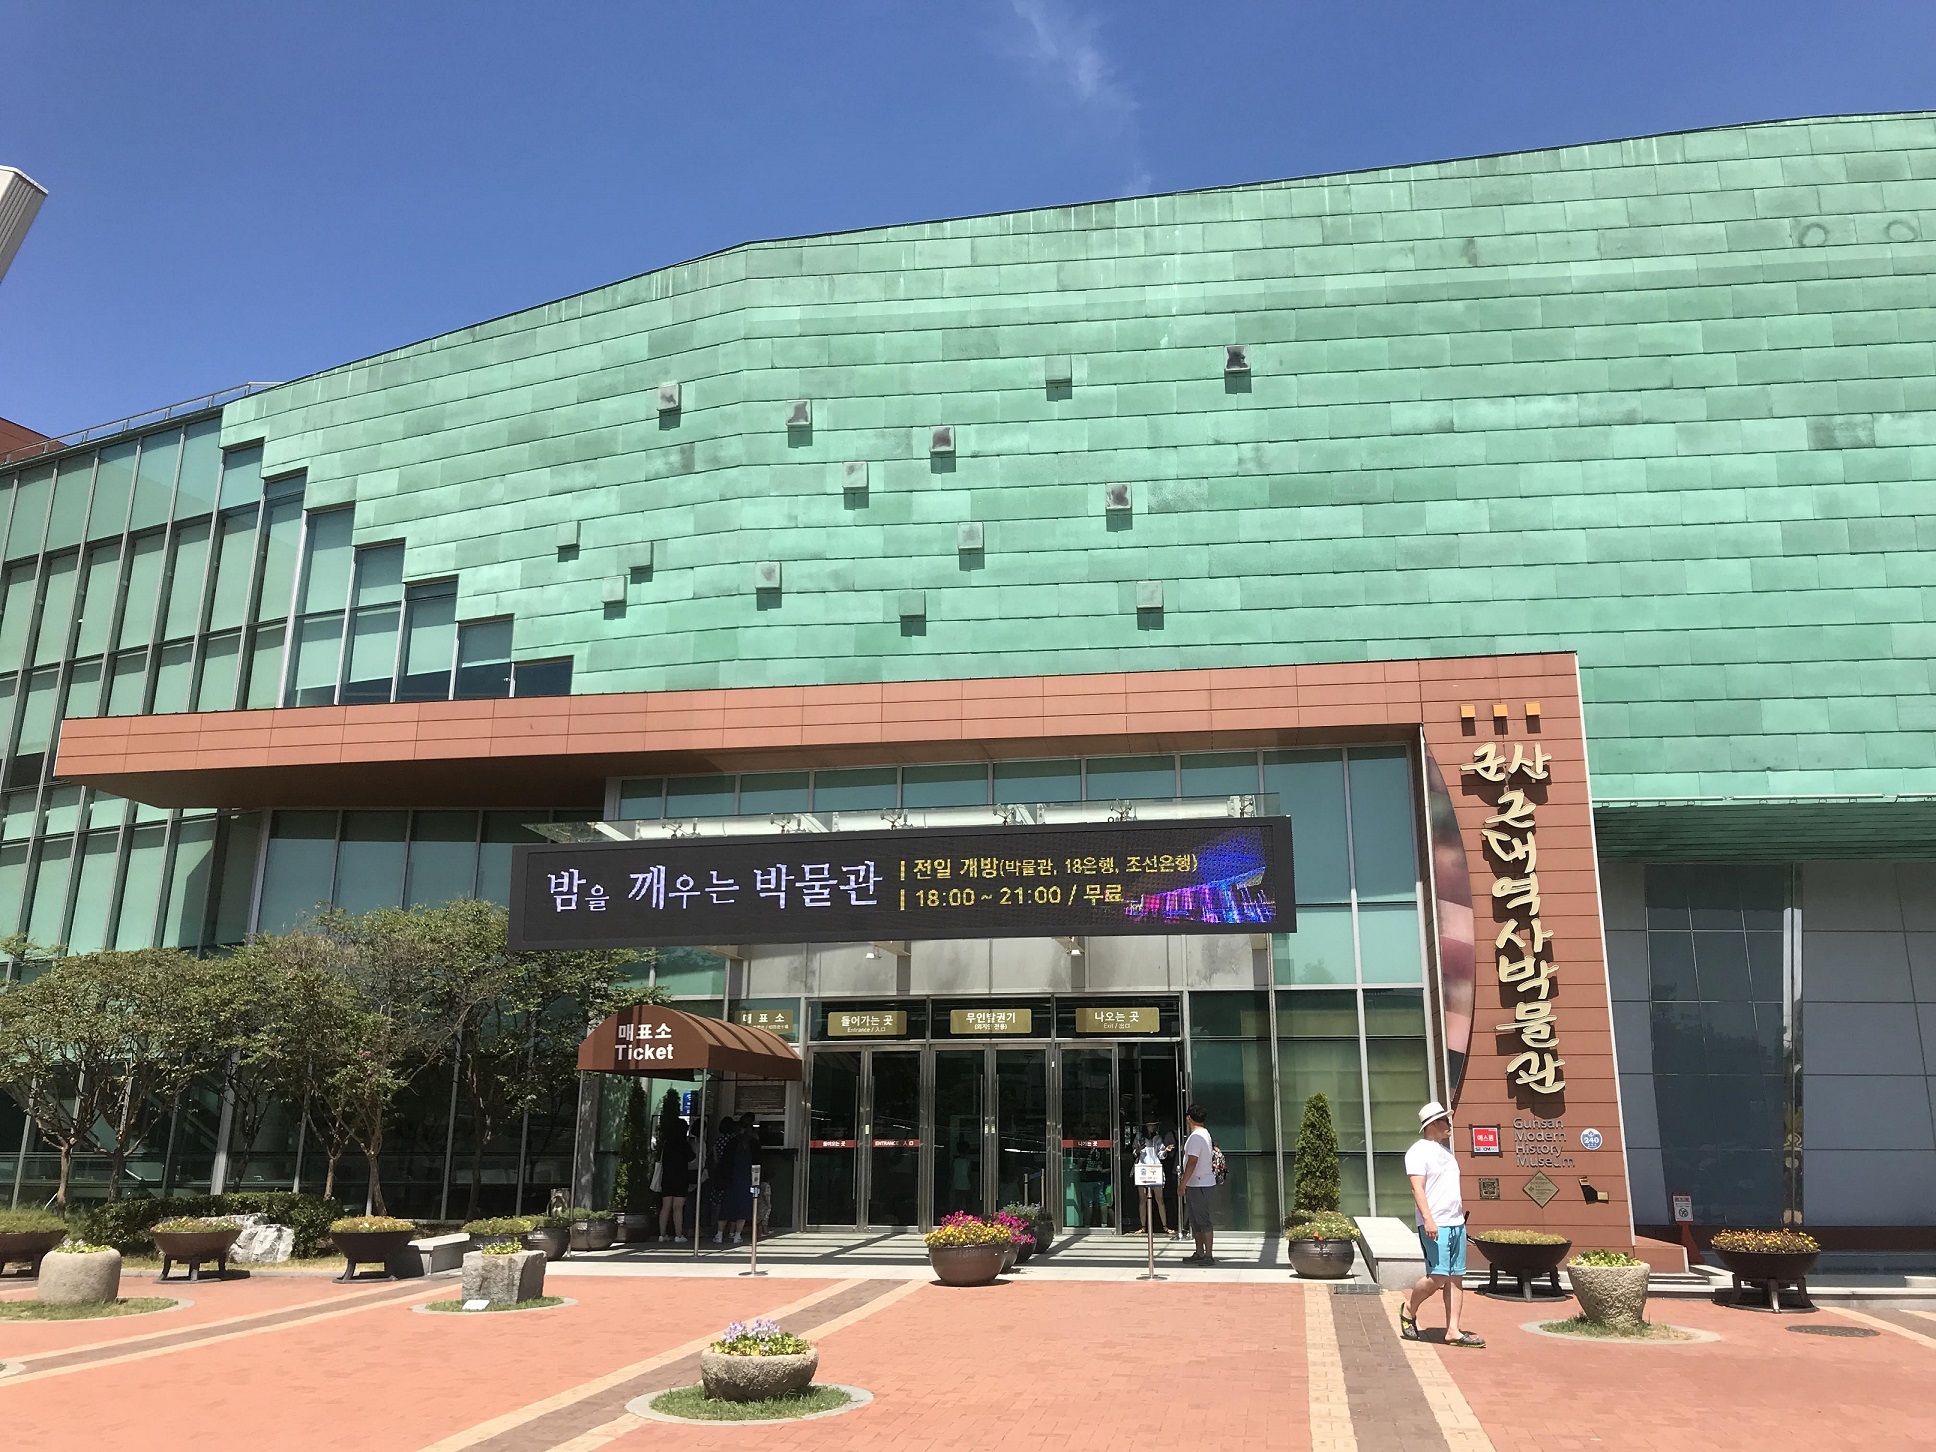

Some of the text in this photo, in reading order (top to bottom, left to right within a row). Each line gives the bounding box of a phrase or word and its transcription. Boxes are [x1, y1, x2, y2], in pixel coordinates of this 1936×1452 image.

[1460, 742, 1552, 781] 군산
[913, 853, 1198, 880] 전일 개방(박물관, 18은행, 조선은행)
[548, 860, 883, 912] 밤을 깨우는 박물관
[915, 888, 975, 907] 18:00
[1000, 885, 1062, 905] 21:00
[1083, 884, 1125, 906] 무료
[1482, 789, 1566, 1094] 근대역사박물관
[841, 1014, 893, 1027] 들어가는 곳
[1095, 1011, 1139, 1022] 나오는 곳
[618, 1022, 672, 1041] 매표소
[614, 1043, 674, 1060] Ticket
[1513, 1117, 1563, 1129] Gunsan
[1515, 1130, 1567, 1142] Modern
[1515, 1141, 1563, 1158] History
[1516, 1155, 1575, 1168] Museum
